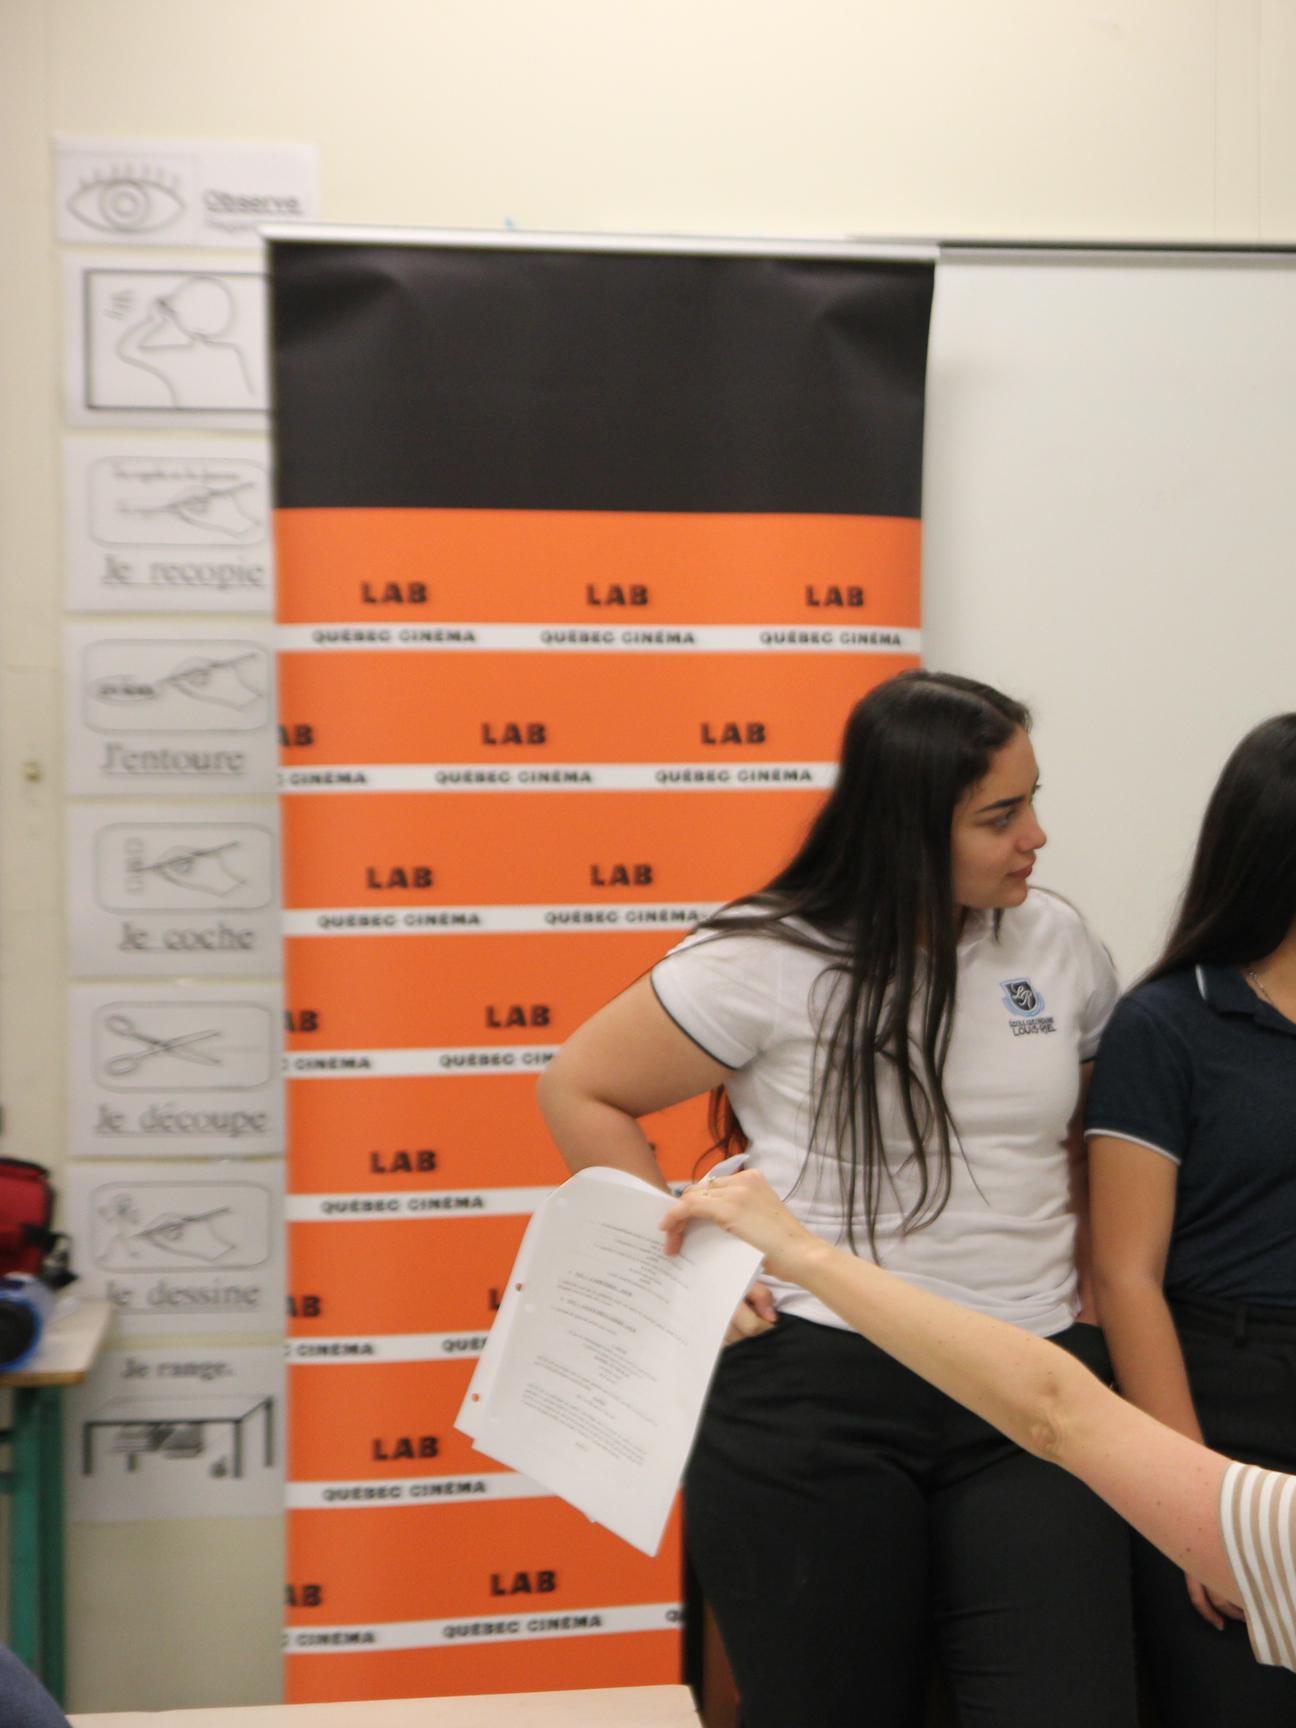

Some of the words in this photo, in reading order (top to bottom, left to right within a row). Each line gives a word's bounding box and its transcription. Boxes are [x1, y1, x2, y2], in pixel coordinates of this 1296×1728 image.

[361, 581, 429, 604] LAB
[587, 583, 650, 606] LAB
[805, 585, 865, 607] LAB
[277, 724, 315, 747] AB
[482, 722, 547, 746] LAB
[699, 721, 767, 745] LAB
[365, 866, 434, 889] LAB
[590, 863, 654, 887] LAB
[485, 1004, 552, 1029] LAB
[370, 1150, 438, 1174] LAB
[373, 1436, 440, 1461] LAB
[490, 1570, 557, 1597] LAB
